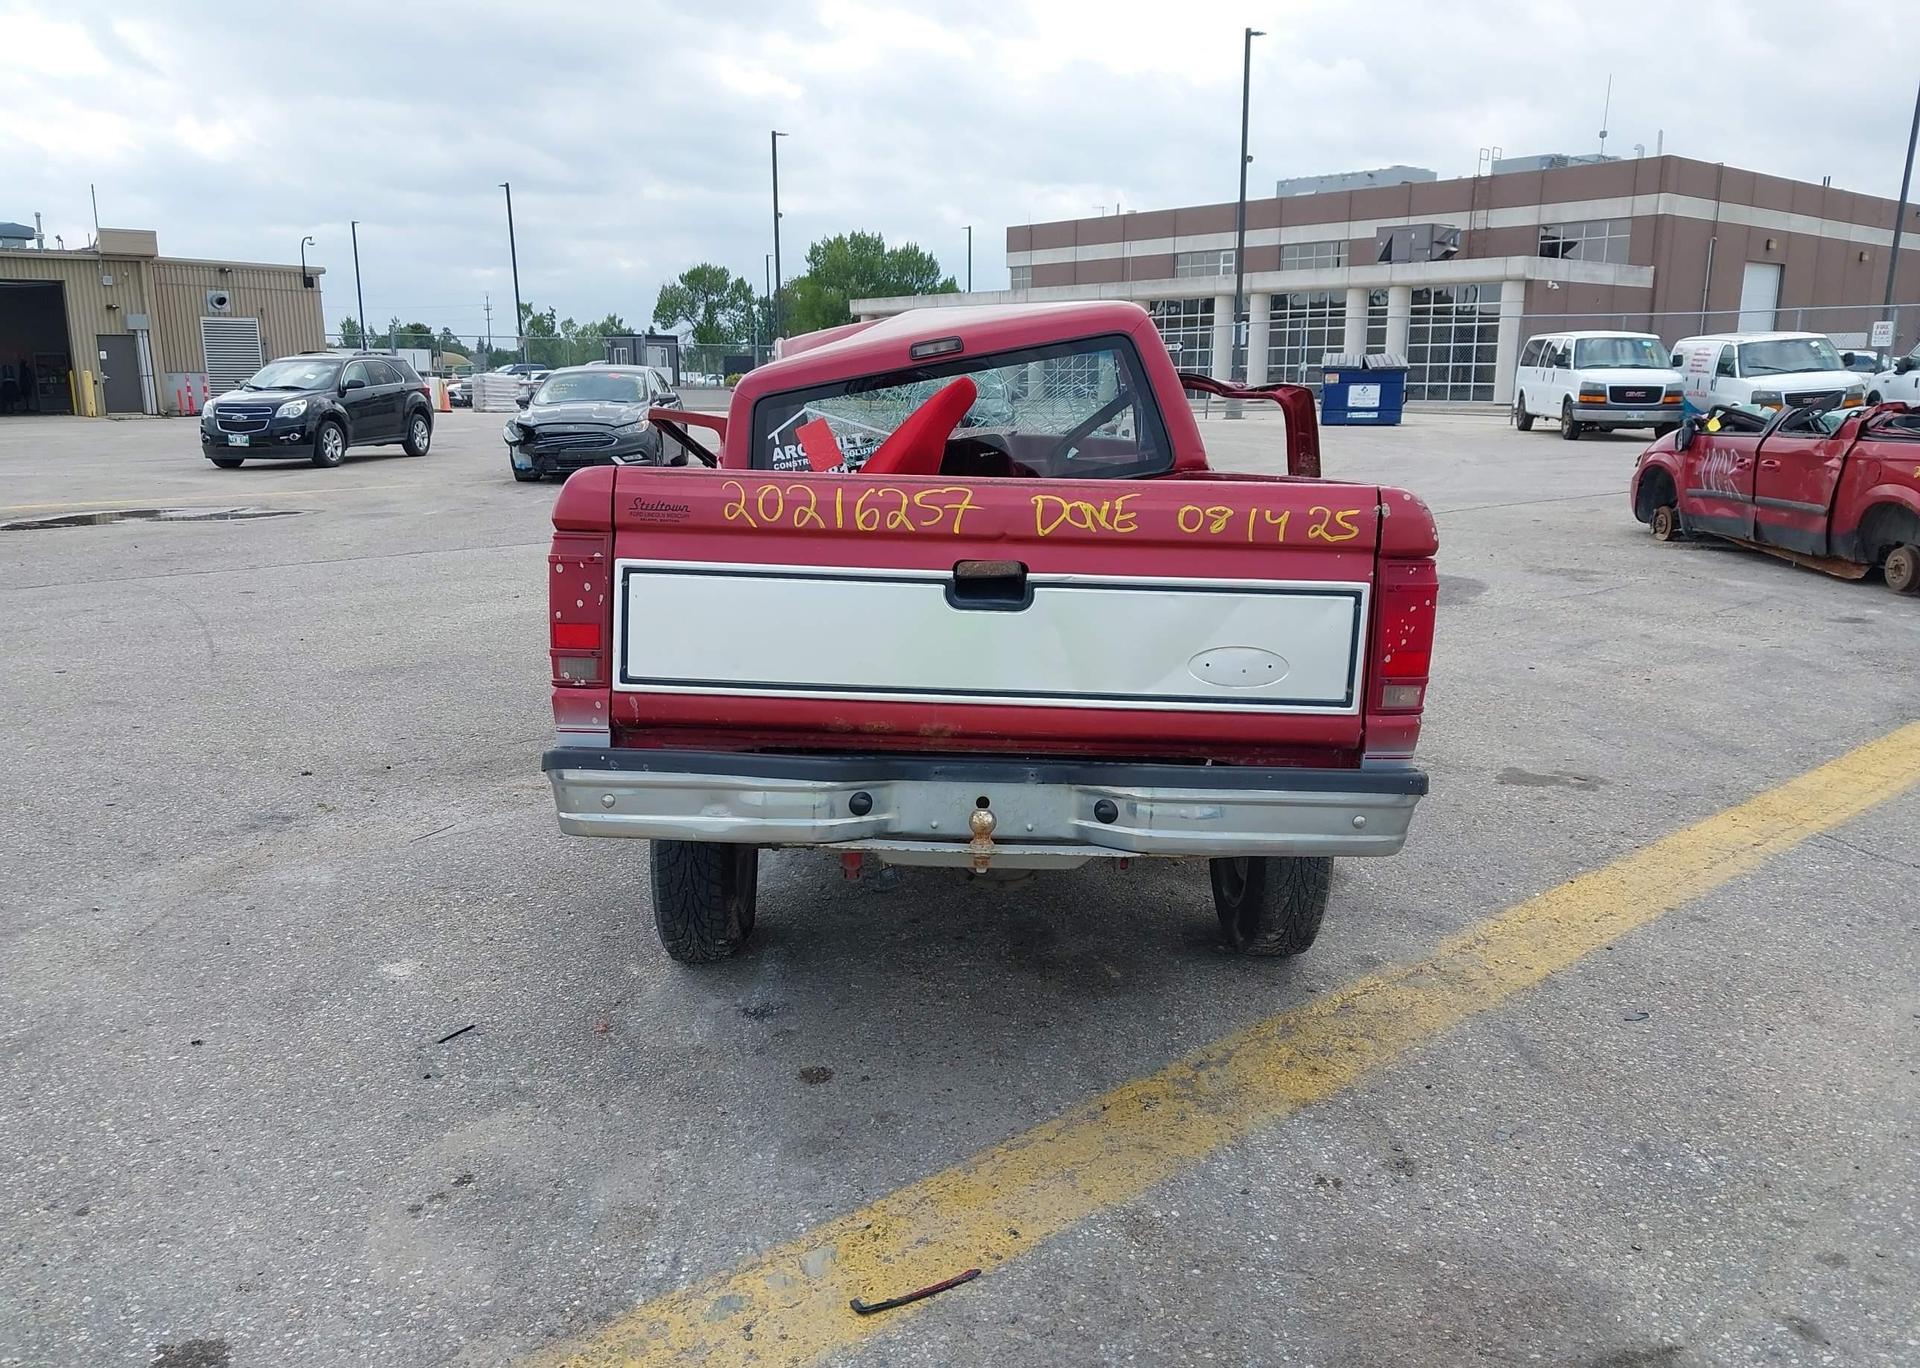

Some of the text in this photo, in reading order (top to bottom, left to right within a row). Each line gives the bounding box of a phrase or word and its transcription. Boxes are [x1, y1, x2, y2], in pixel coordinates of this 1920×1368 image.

[628, 496, 692, 513] Steeltown
[721, 480, 985, 535] 20216257
[1031, 493, 1143, 537] DONE
[1307, 506, 1361, 542] 25
